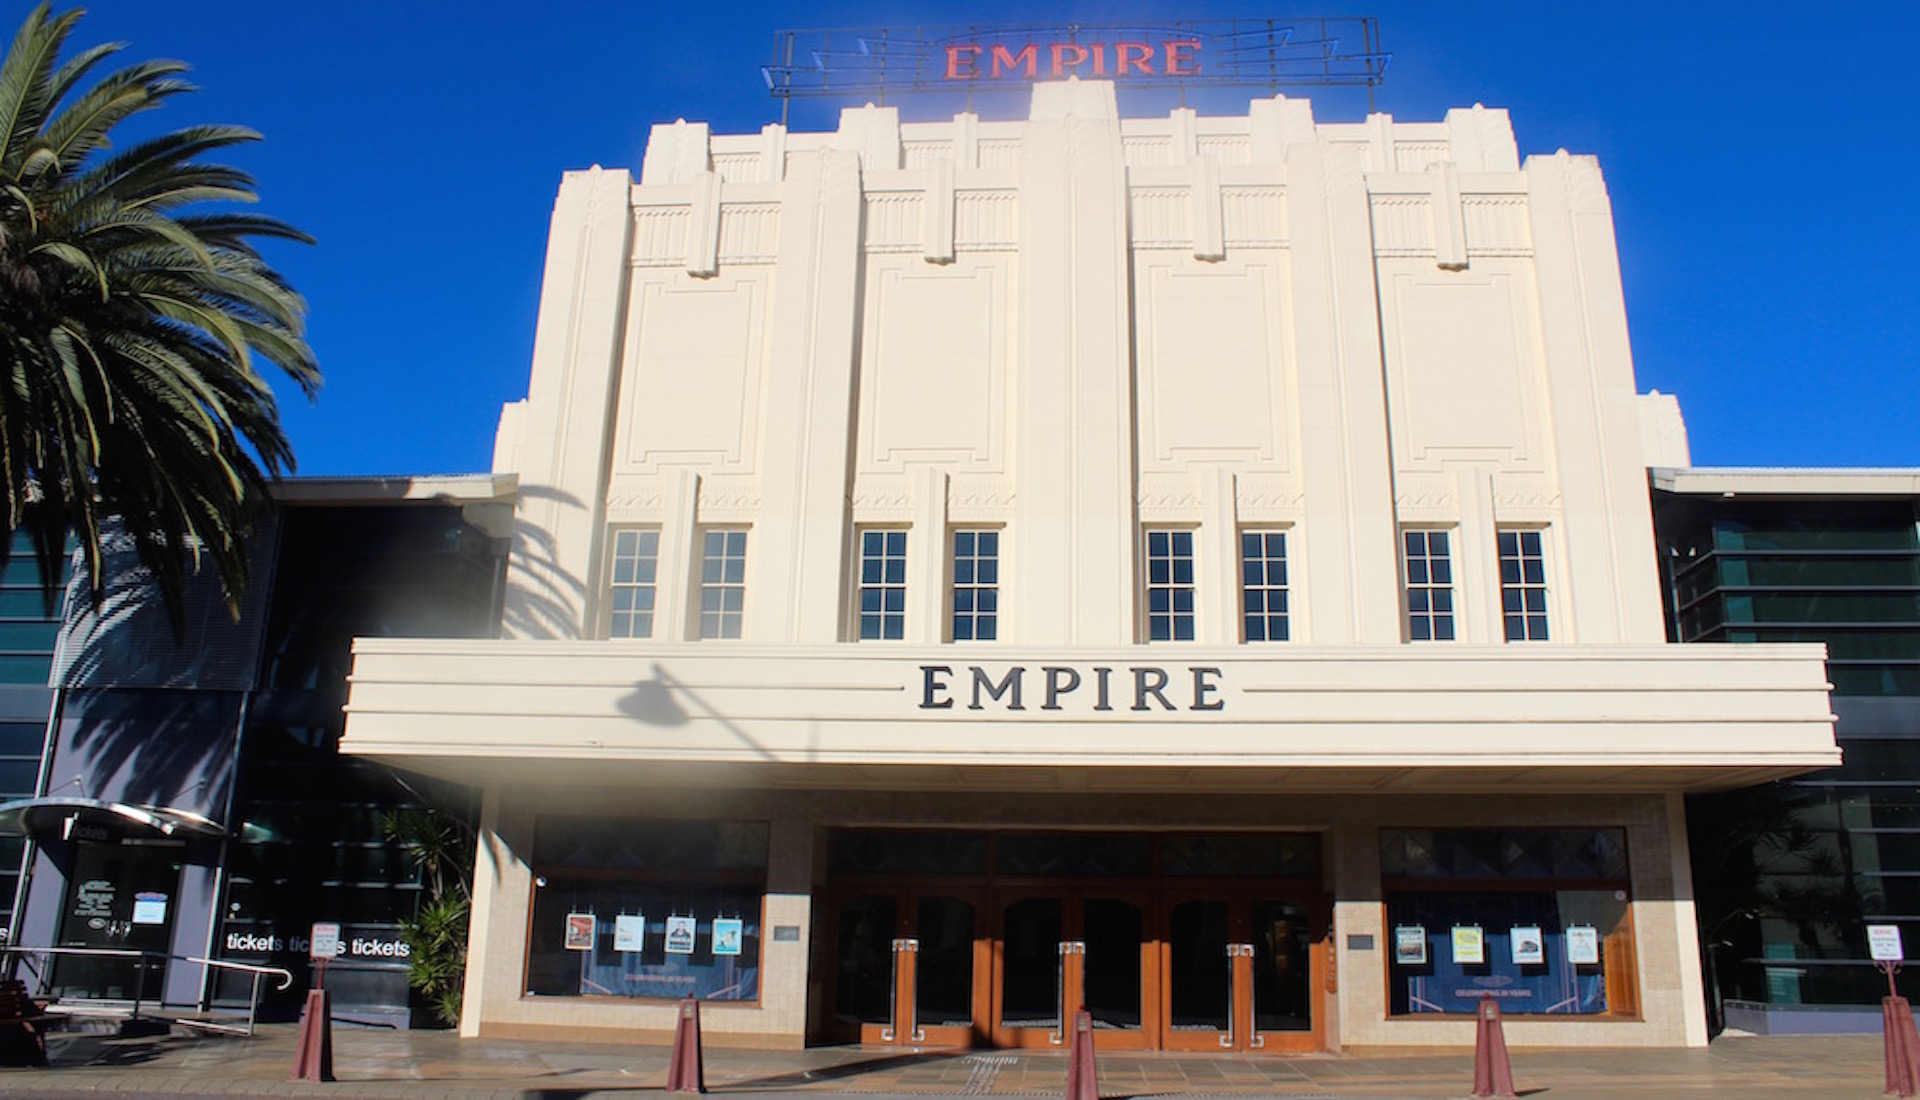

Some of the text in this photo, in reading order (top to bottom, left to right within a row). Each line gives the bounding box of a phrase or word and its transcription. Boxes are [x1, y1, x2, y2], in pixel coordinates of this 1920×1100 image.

[943, 40, 1203, 80] EMPIRE
[918, 666, 1225, 711] EMPIRE
[226, 933, 283, 951] tickets
[352, 938, 411, 957] tickets
